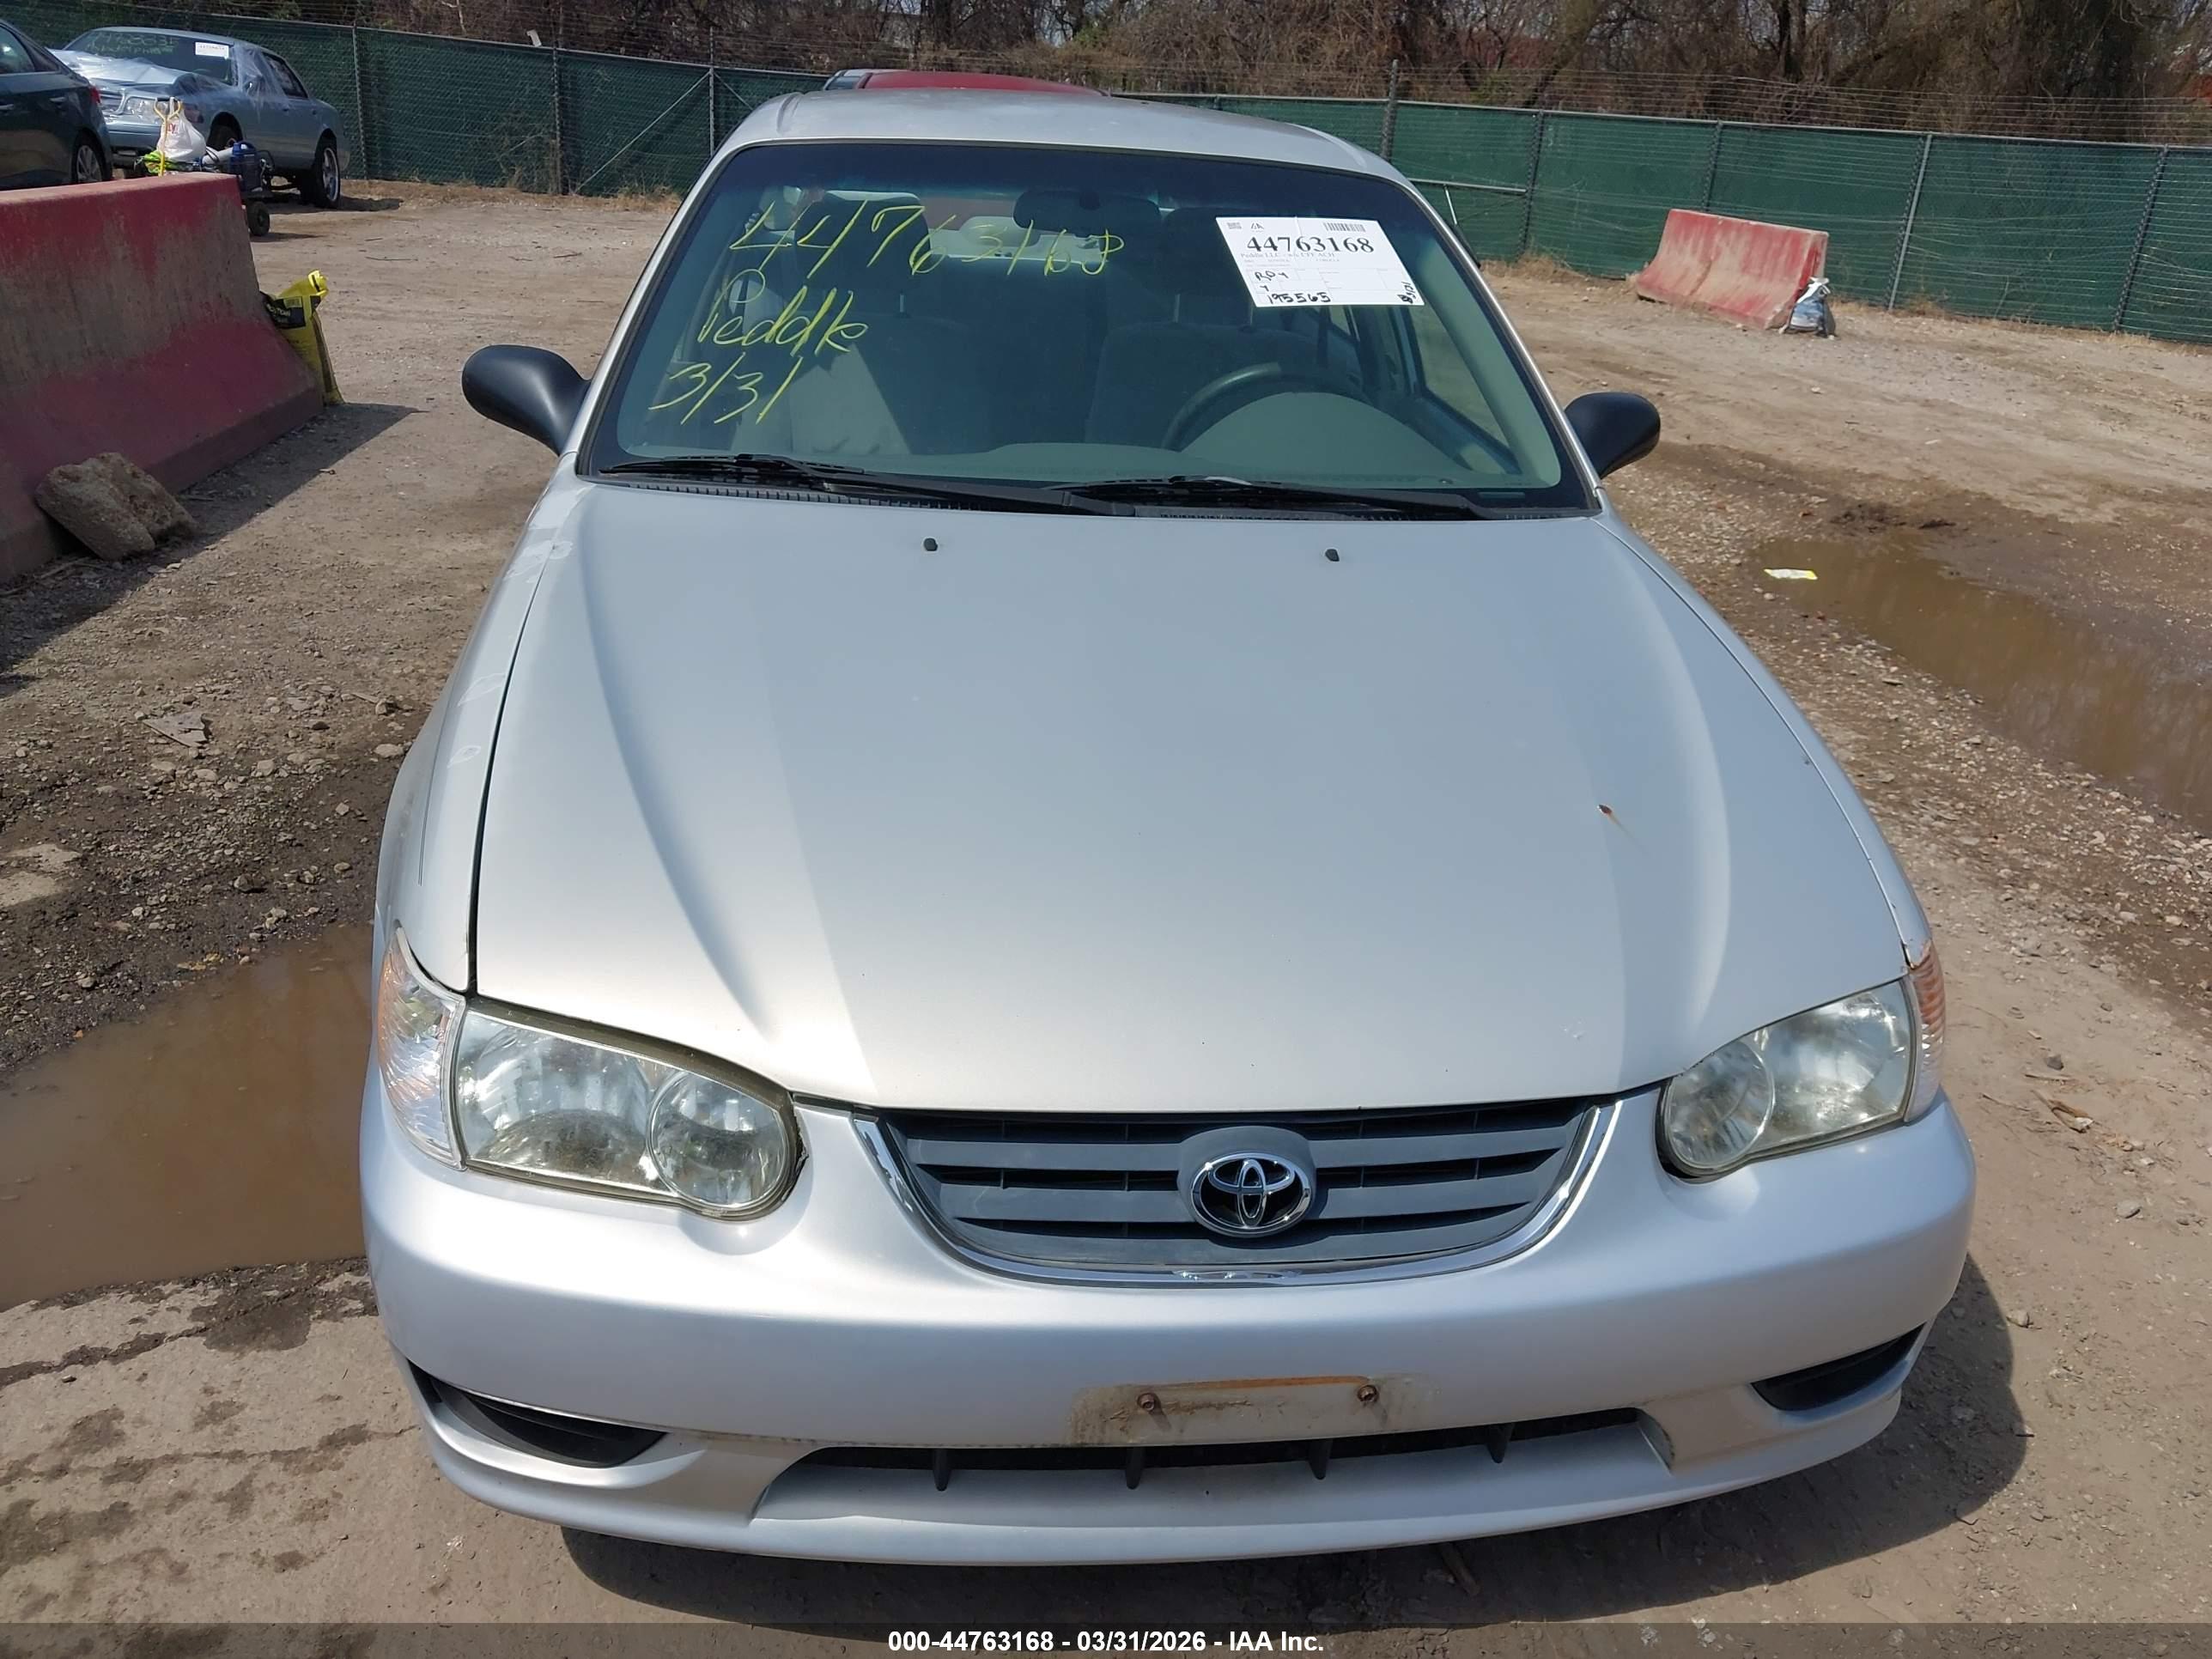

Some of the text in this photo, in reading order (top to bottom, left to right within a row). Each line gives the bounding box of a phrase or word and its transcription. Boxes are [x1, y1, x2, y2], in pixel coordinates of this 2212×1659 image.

[730, 198, 1124, 279] 44763168
[1247, 235, 1375, 253] 44763168
[1267, 291, 1332, 305] 195565
[647, 351, 803, 425] 3/31
